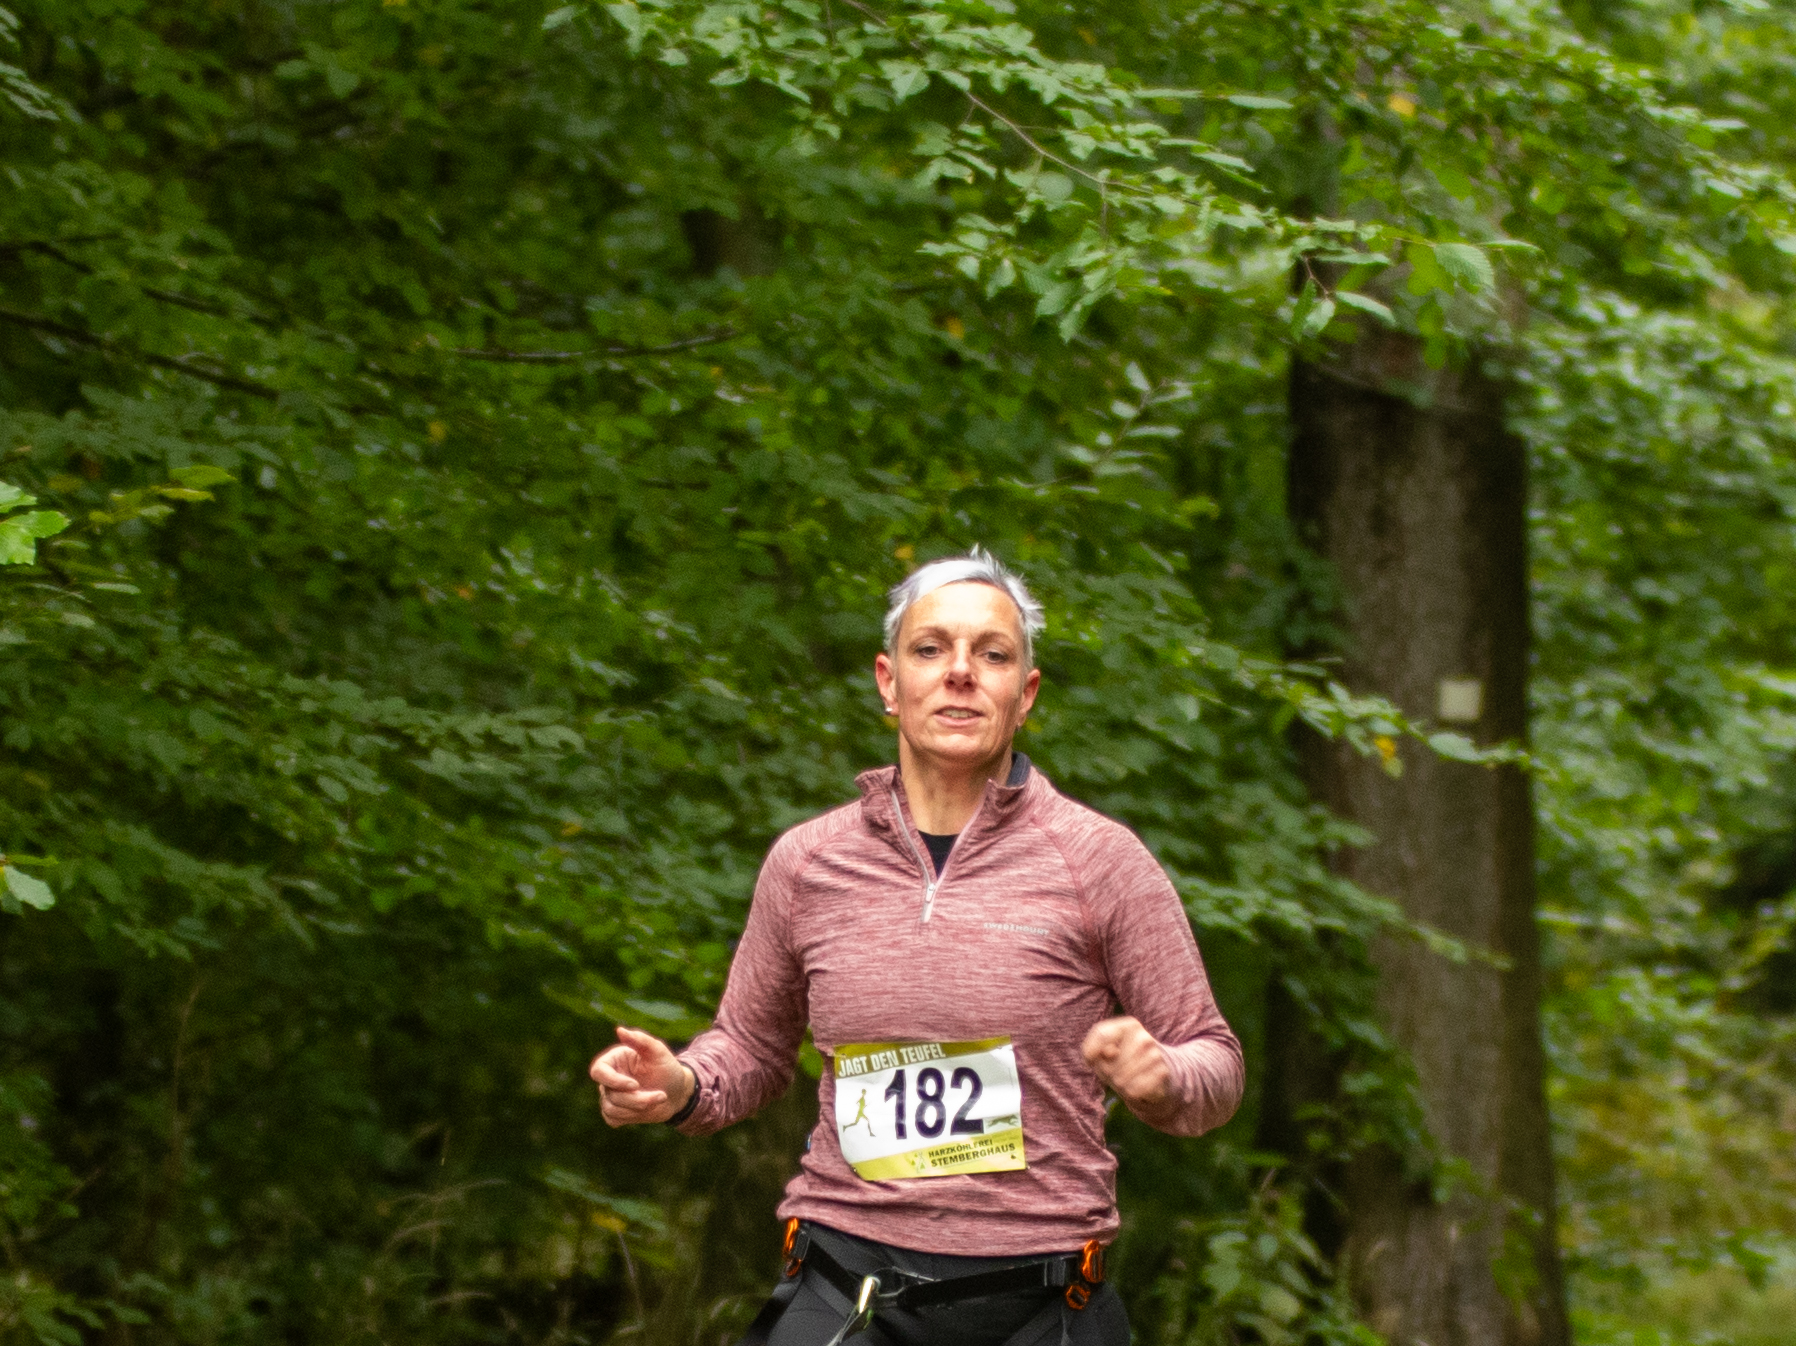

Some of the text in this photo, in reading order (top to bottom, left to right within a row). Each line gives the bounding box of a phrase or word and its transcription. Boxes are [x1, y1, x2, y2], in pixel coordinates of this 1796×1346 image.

[838, 1043, 946, 1077] JAGT DEN TEUFEL
[885, 1067, 984, 1140] 182
[930, 1142, 1016, 1168] STEMBERGHAUS
